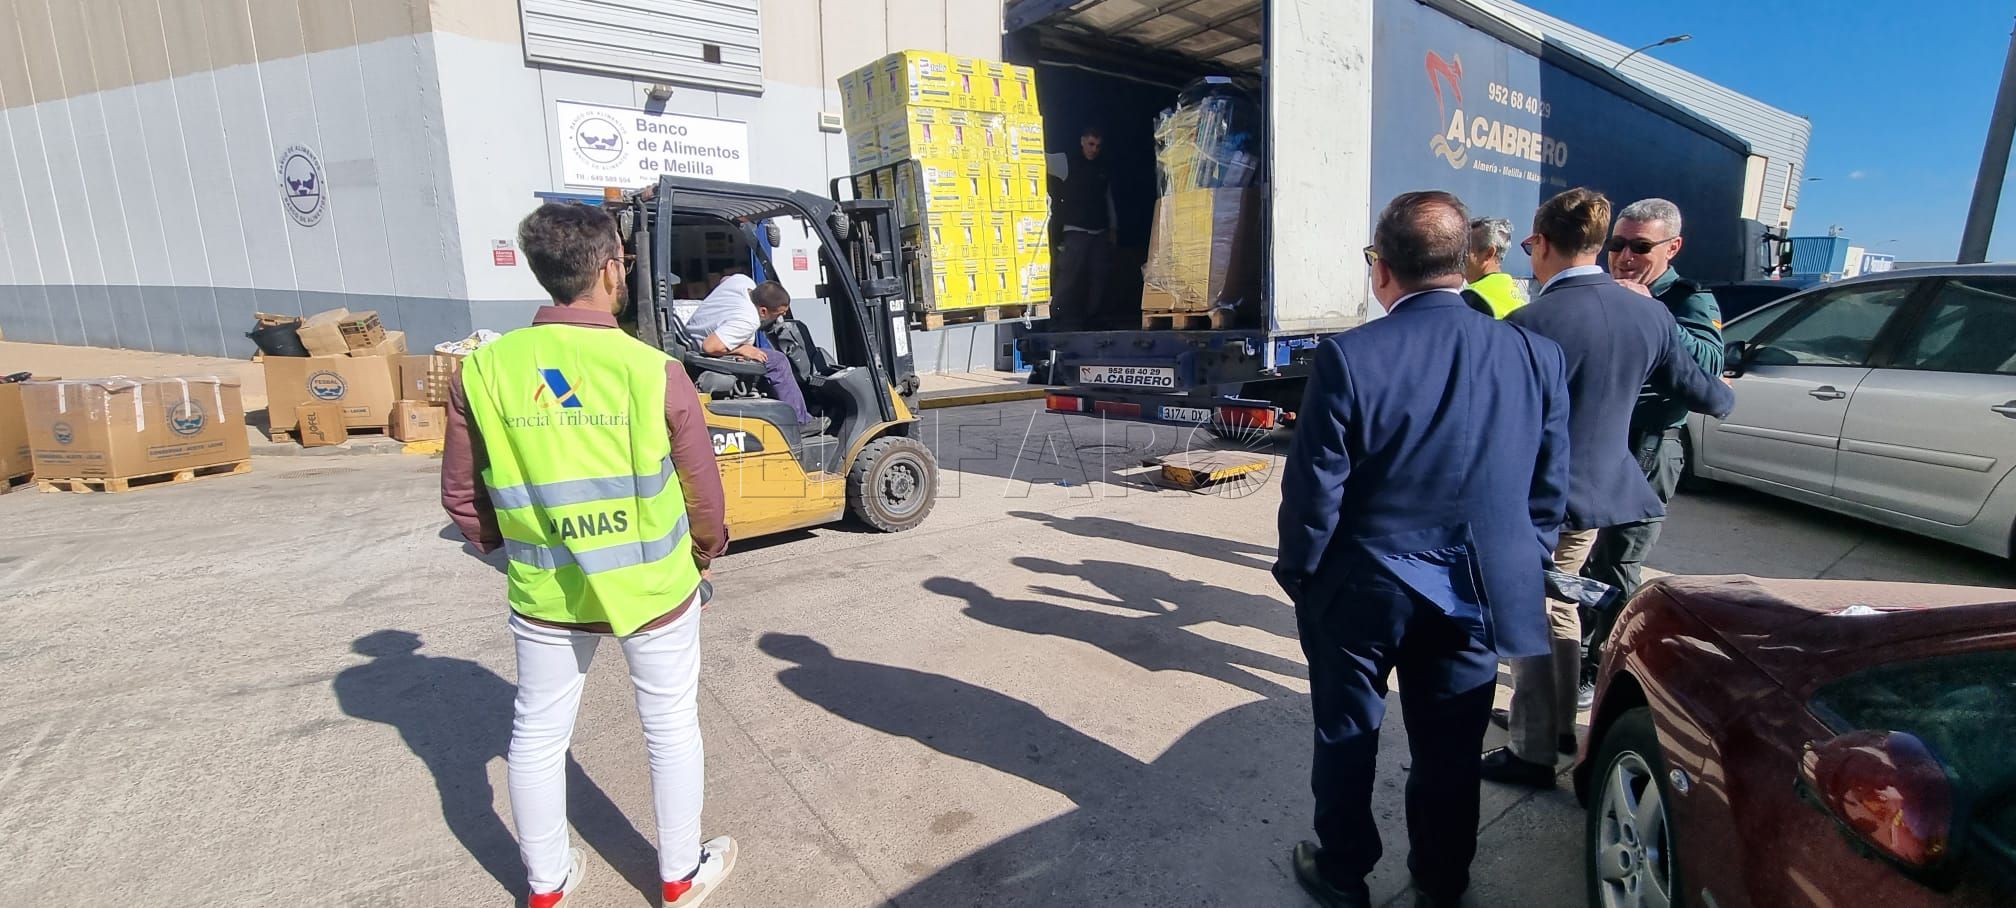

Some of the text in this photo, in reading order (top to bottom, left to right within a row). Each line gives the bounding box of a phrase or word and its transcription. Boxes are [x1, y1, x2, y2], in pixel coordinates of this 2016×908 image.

[1488, 82, 1508, 105] 952
[1511, 91, 1523, 110] 68
[1525, 96, 1538, 115] 40
[636, 118, 688, 136] Banco
[1447, 109, 1568, 168] A.CABRERO
[637, 138, 740, 160] de Alimentos
[639, 156, 714, 175] de Melilla
[1502, 166, 1522, 179] Melilla
[889, 300, 904, 312] CAT
[1150, 368, 1161, 376] 29
[1164, 407, 1186, 420] 3174
[308, 412, 325, 441] JOFEL
[713, 432, 747, 455] CAT
